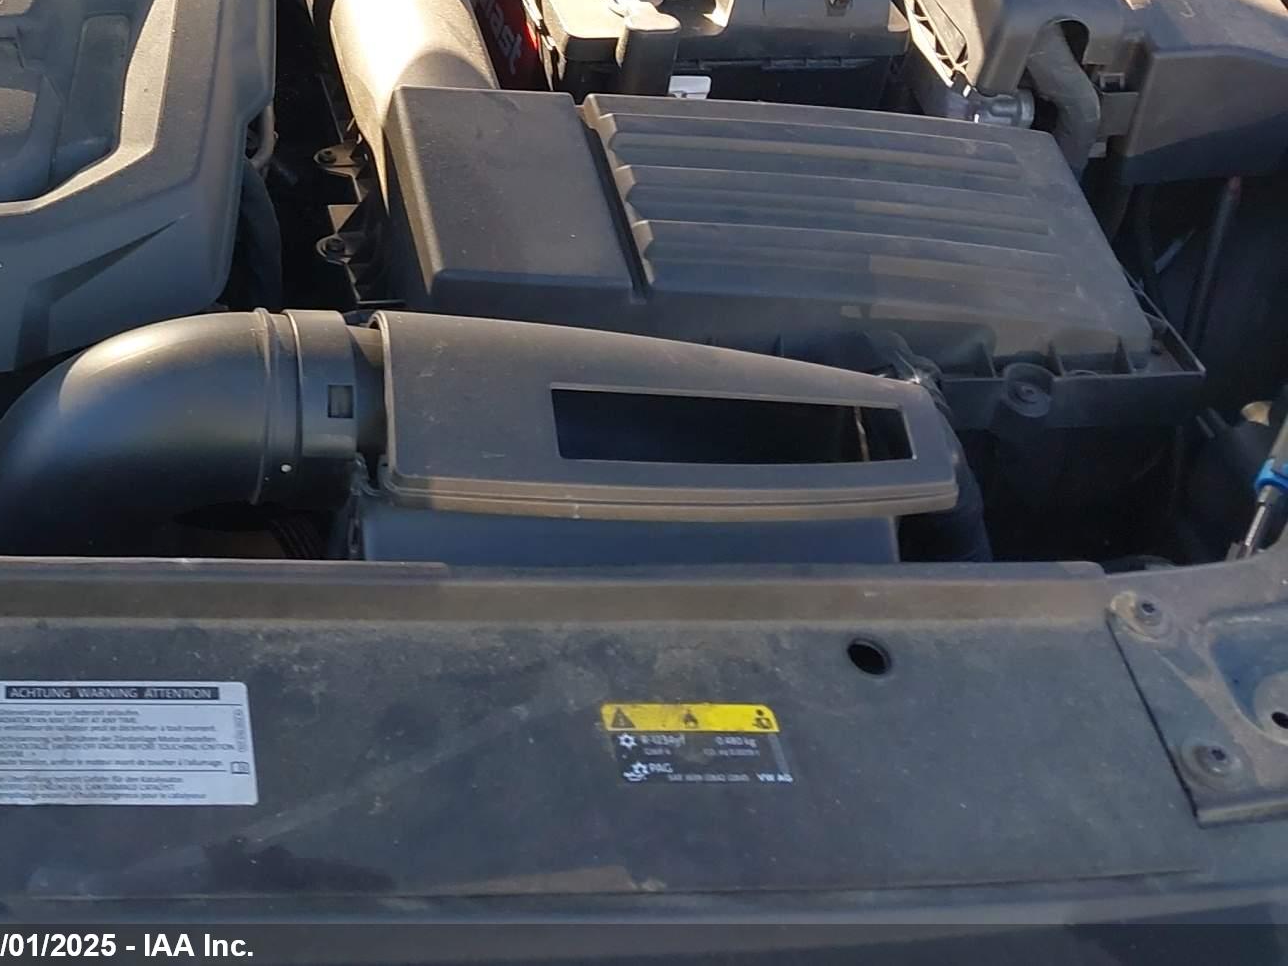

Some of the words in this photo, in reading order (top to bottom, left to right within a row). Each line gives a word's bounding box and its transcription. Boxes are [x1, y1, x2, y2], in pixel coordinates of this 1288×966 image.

[9, 687, 72, 699] ACHTUNG
[78, 688, 139, 699] WARNING
[144, 688, 212, 700] ATTENTION
